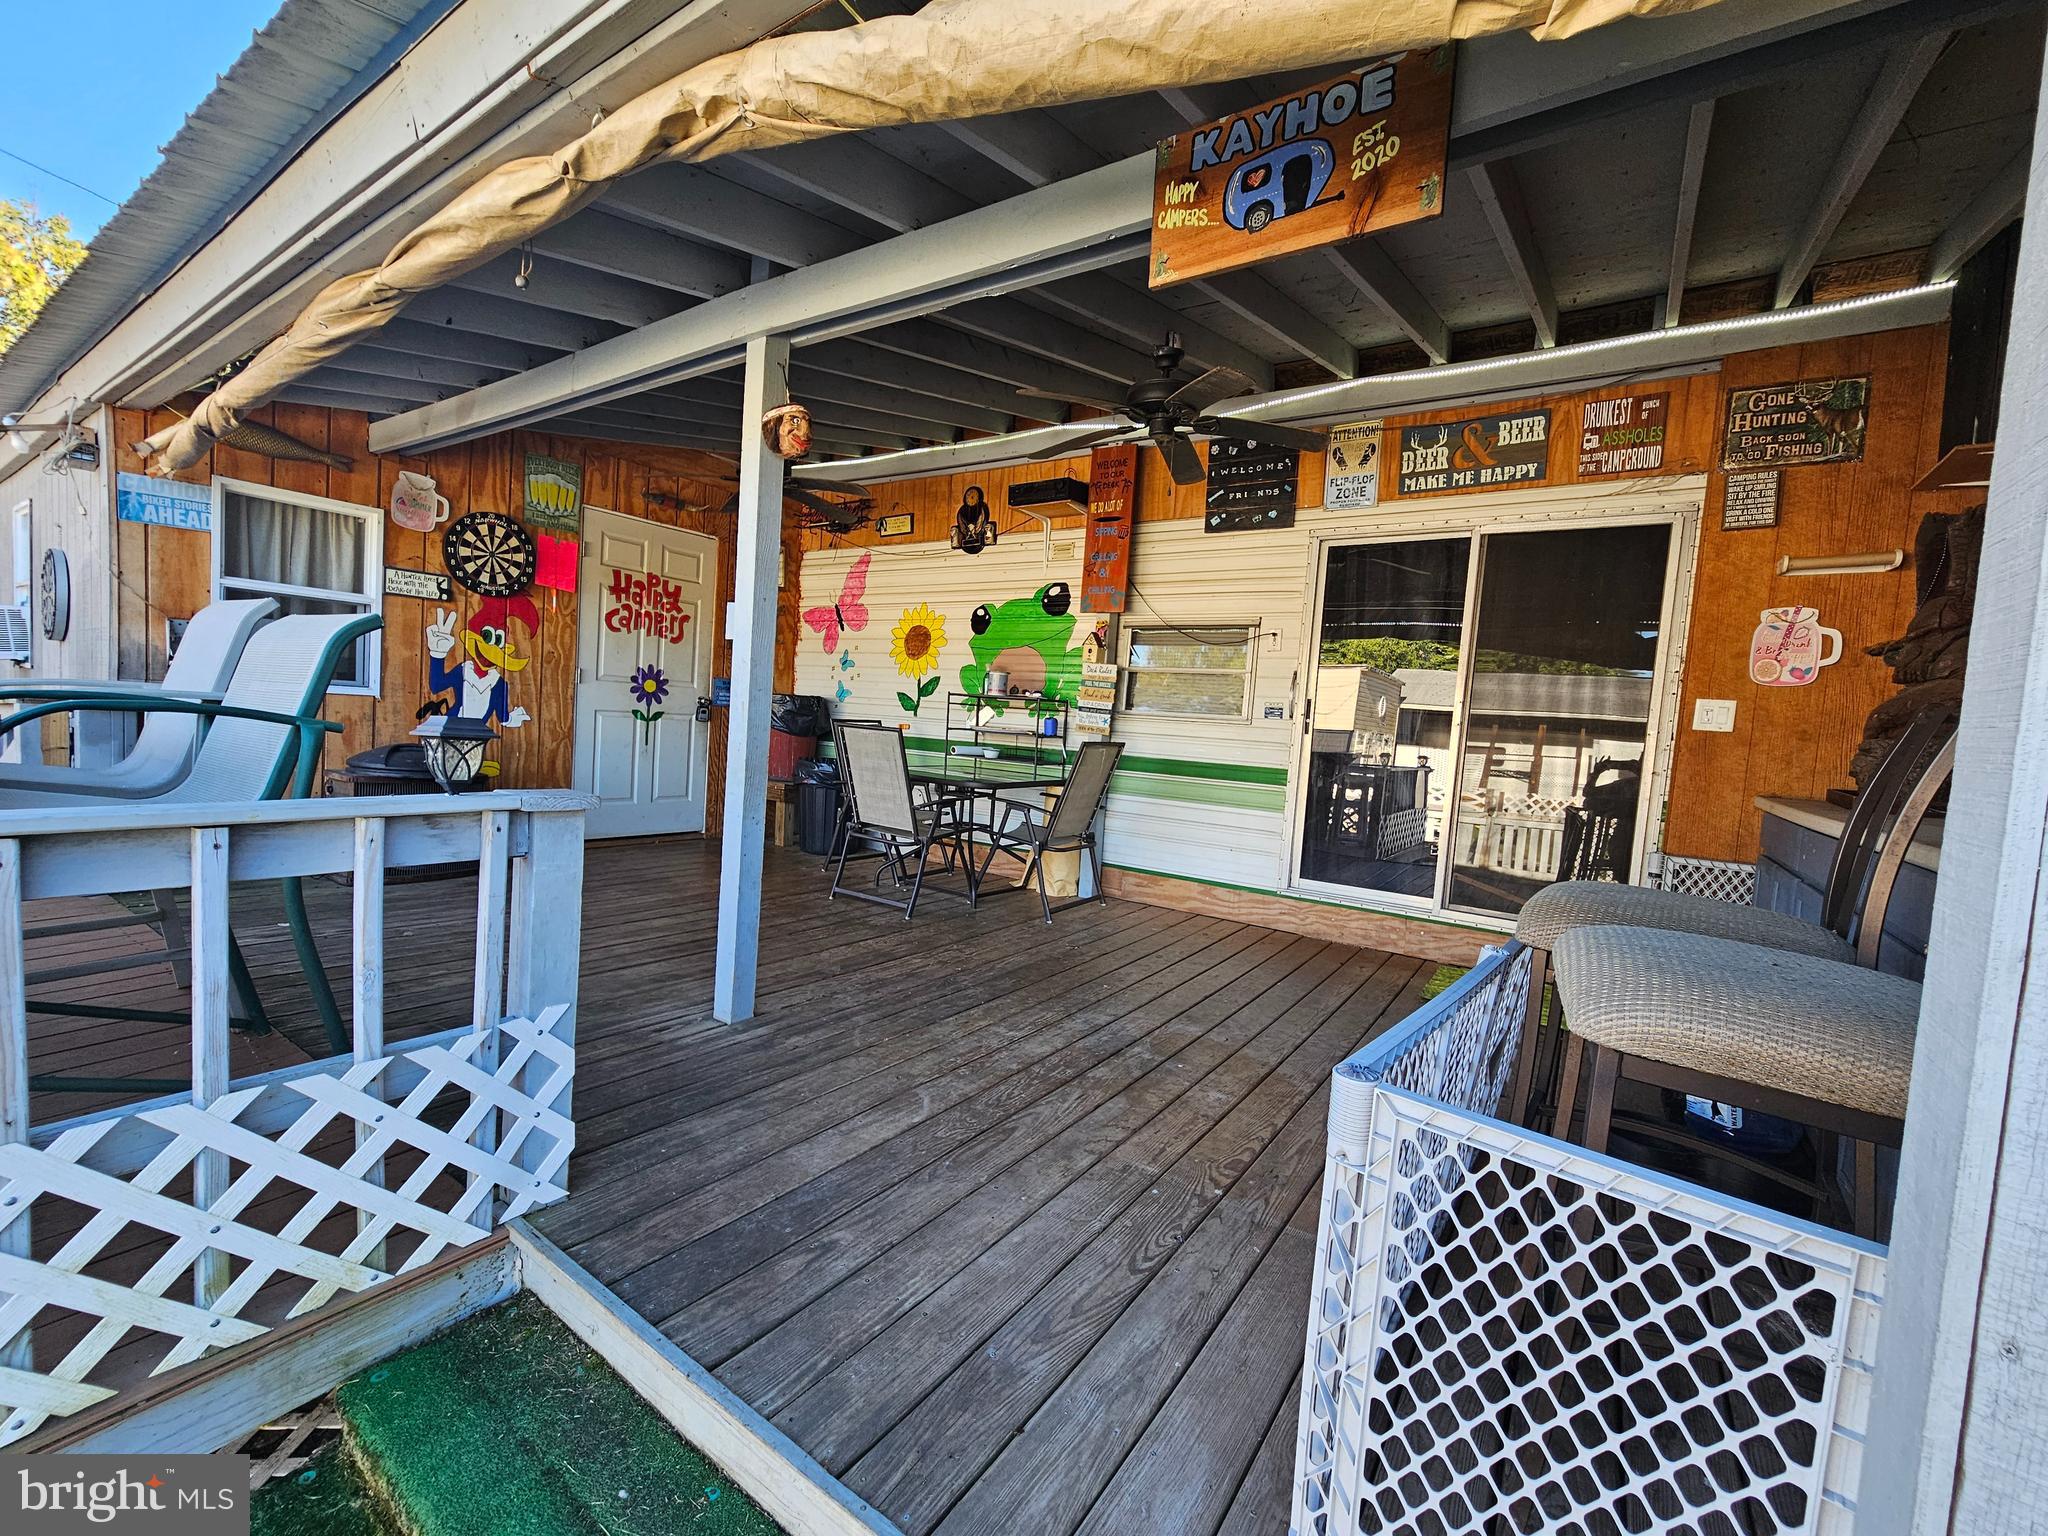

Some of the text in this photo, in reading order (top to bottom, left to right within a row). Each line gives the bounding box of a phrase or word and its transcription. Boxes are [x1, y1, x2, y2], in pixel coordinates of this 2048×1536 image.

[1191, 66, 1395, 172] KAYHOE
[1351, 136, 1400, 181] 2020
[1165, 181, 1199, 205] HAPPY
[1584, 398, 1633, 429] DRUNKEST
[1332, 425, 1379, 441] ATTENTION!
[1401, 416, 1546, 474] DEER & BEER
[1603, 426, 1664, 446] ASSHOLES
[1221, 463, 1284, 476] WELCOME
[1602, 446, 1662, 473] CAMPGROUND
[1404, 463, 1538, 492] MAKE ME HAPPY
[1336, 486, 1367, 499] ZONE
[143, 504, 212, 530] AHEAD
